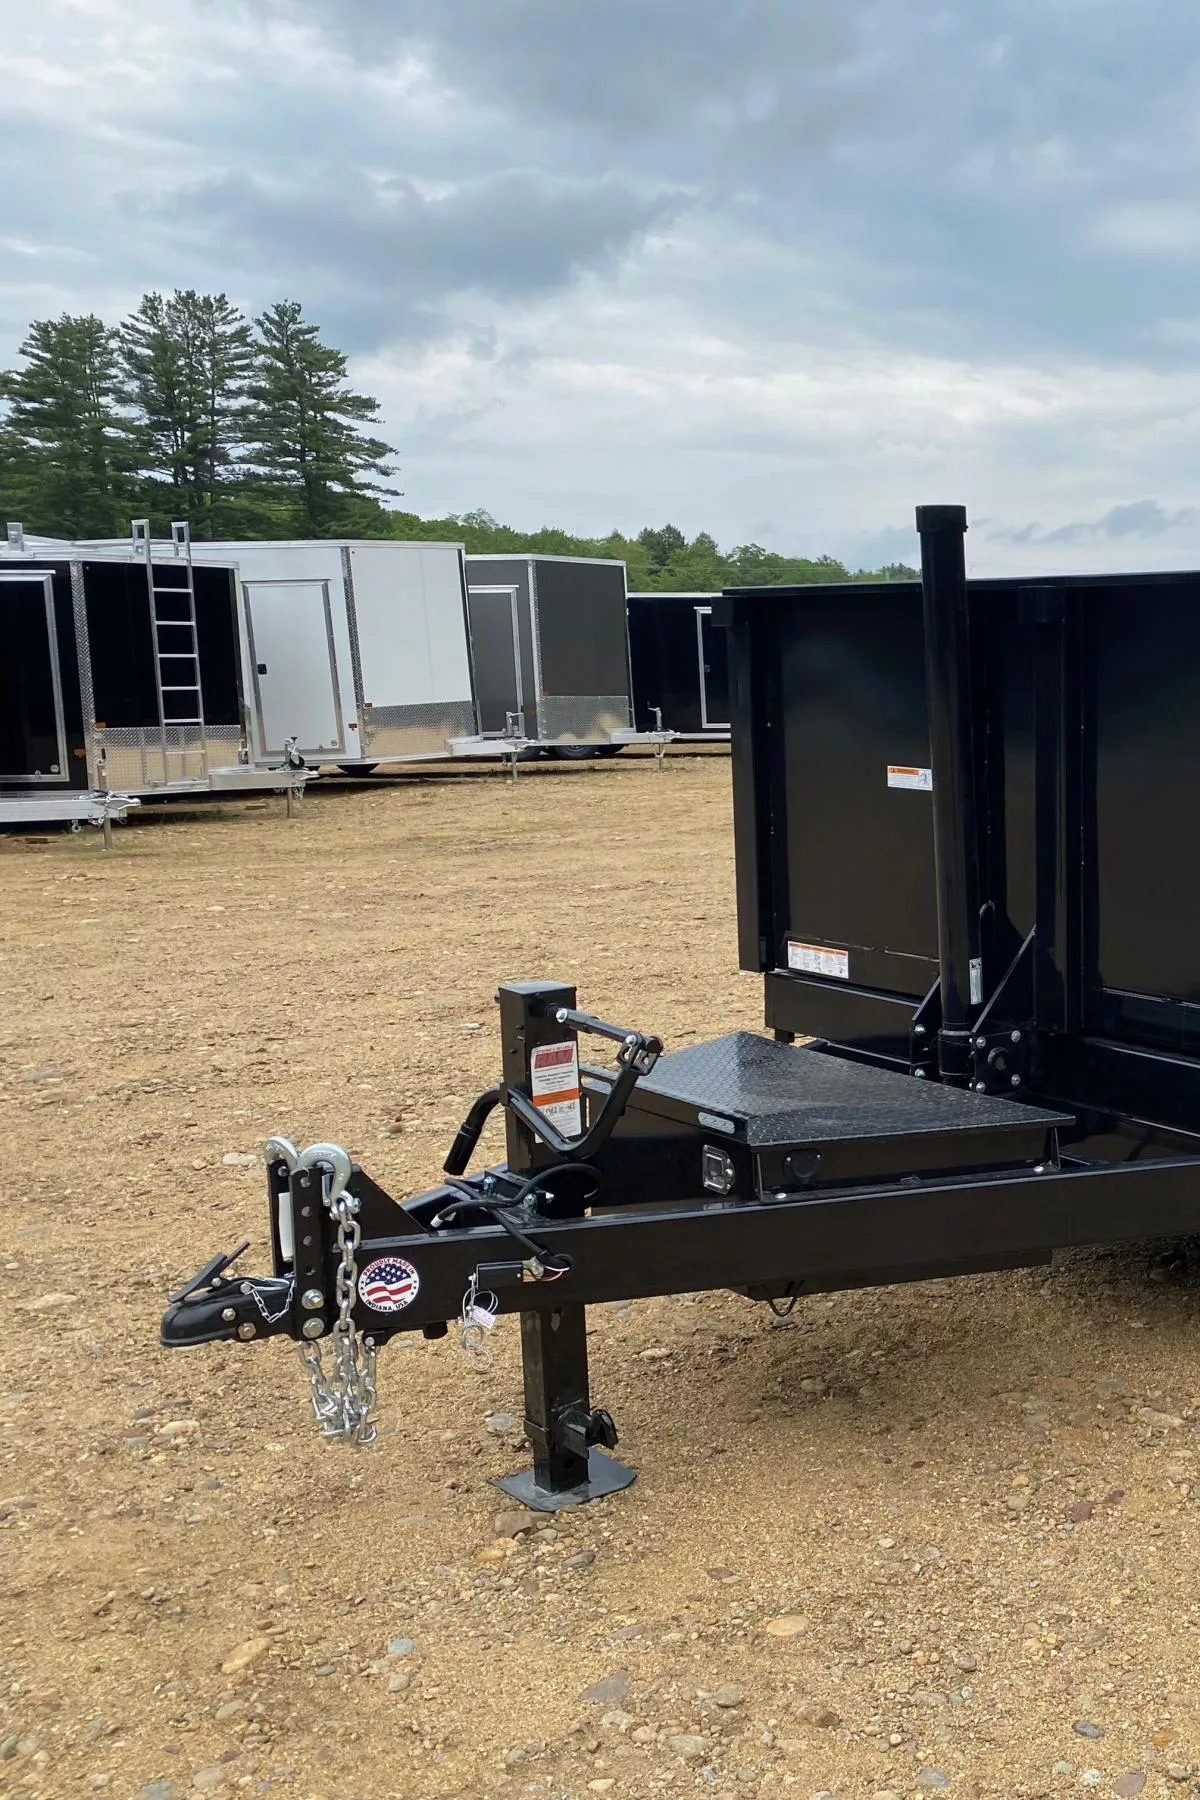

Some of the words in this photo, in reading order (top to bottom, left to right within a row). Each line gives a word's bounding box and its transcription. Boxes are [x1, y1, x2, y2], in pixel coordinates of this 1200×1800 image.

[363, 1259, 390, 1276] PROUDLY
[392, 1259, 410, 1269] MADE
[395, 1299, 408, 1309] USA
